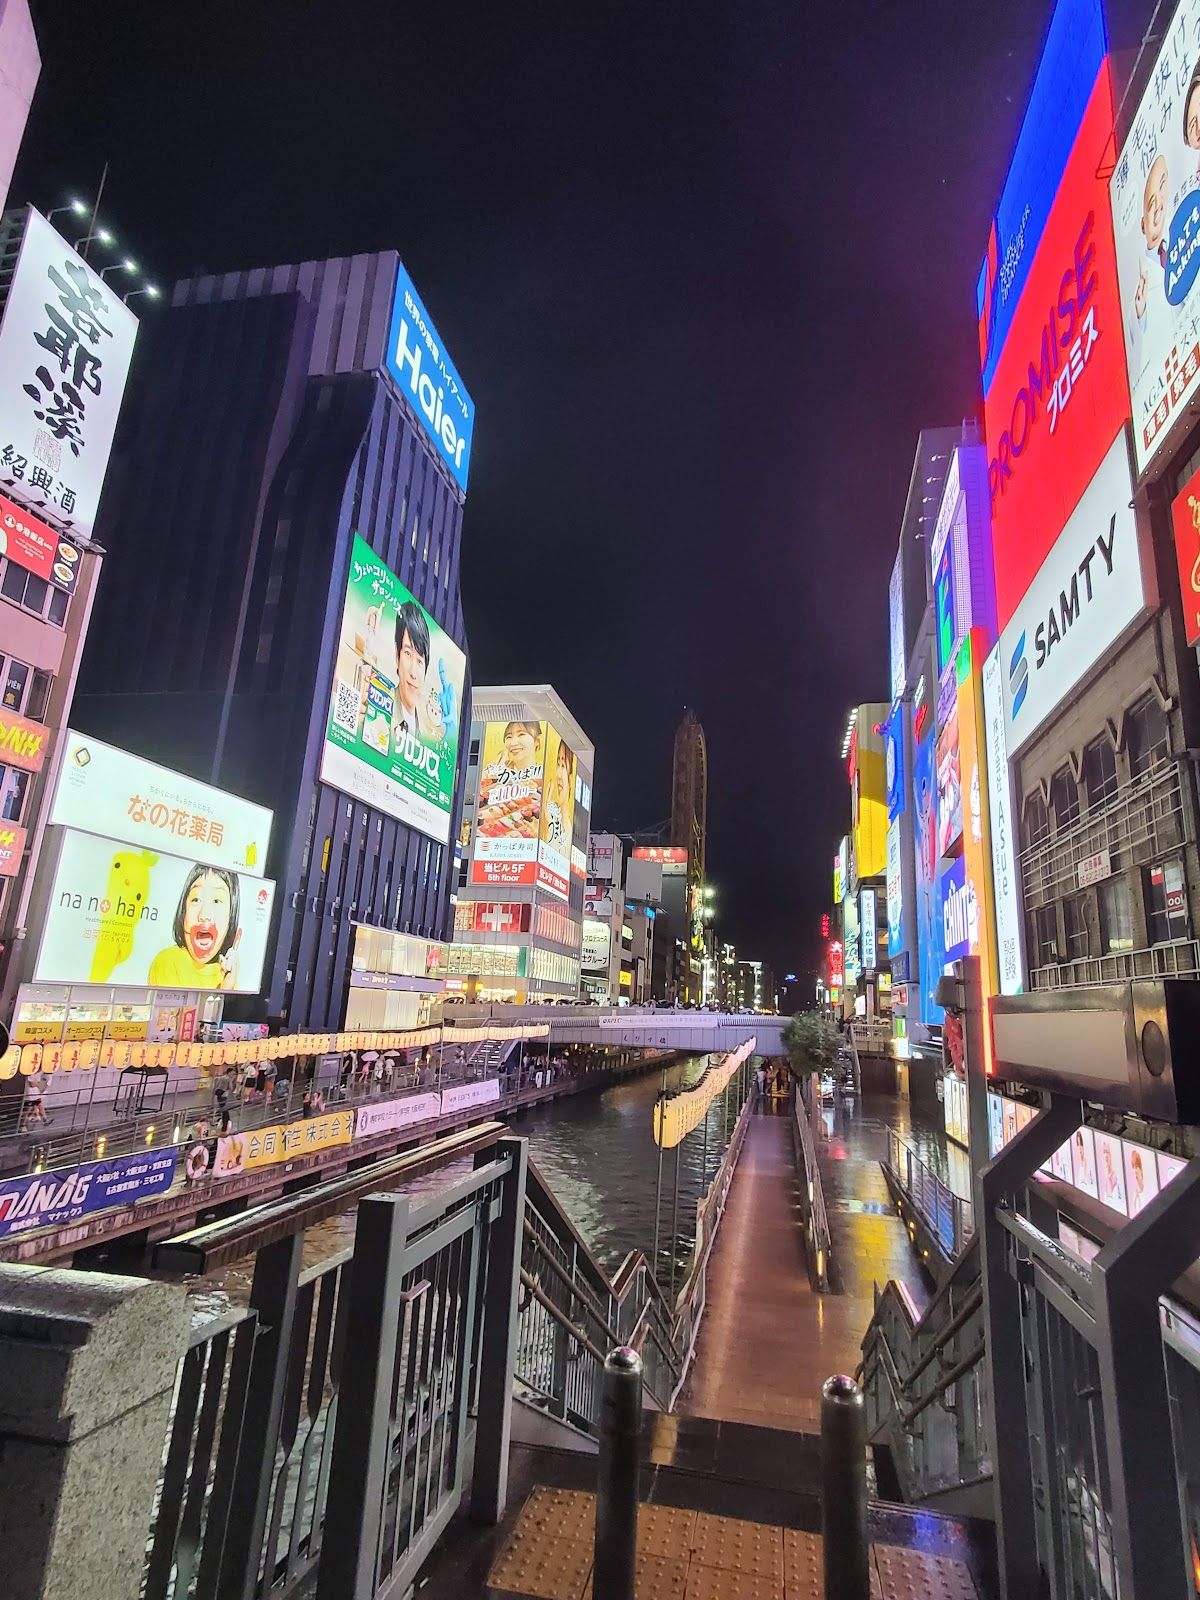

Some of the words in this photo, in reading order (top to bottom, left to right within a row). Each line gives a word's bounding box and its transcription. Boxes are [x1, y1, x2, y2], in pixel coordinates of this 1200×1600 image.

[988, 210, 1098, 502] PROMISE
[1046, 304, 1100, 435] プロミス
[395, 318, 466, 469] Haier
[439, 360, 470, 419] ハイアール
[1141, 375, 1165, 422] AGA
[0, 444, 77, 516] 紹興酒
[1033, 511, 1117, 671] SAMTY
[394, 727, 440, 782] サロンパス
[127, 794, 225, 847] なの花薬局
[501, 873, 521, 882] floor
